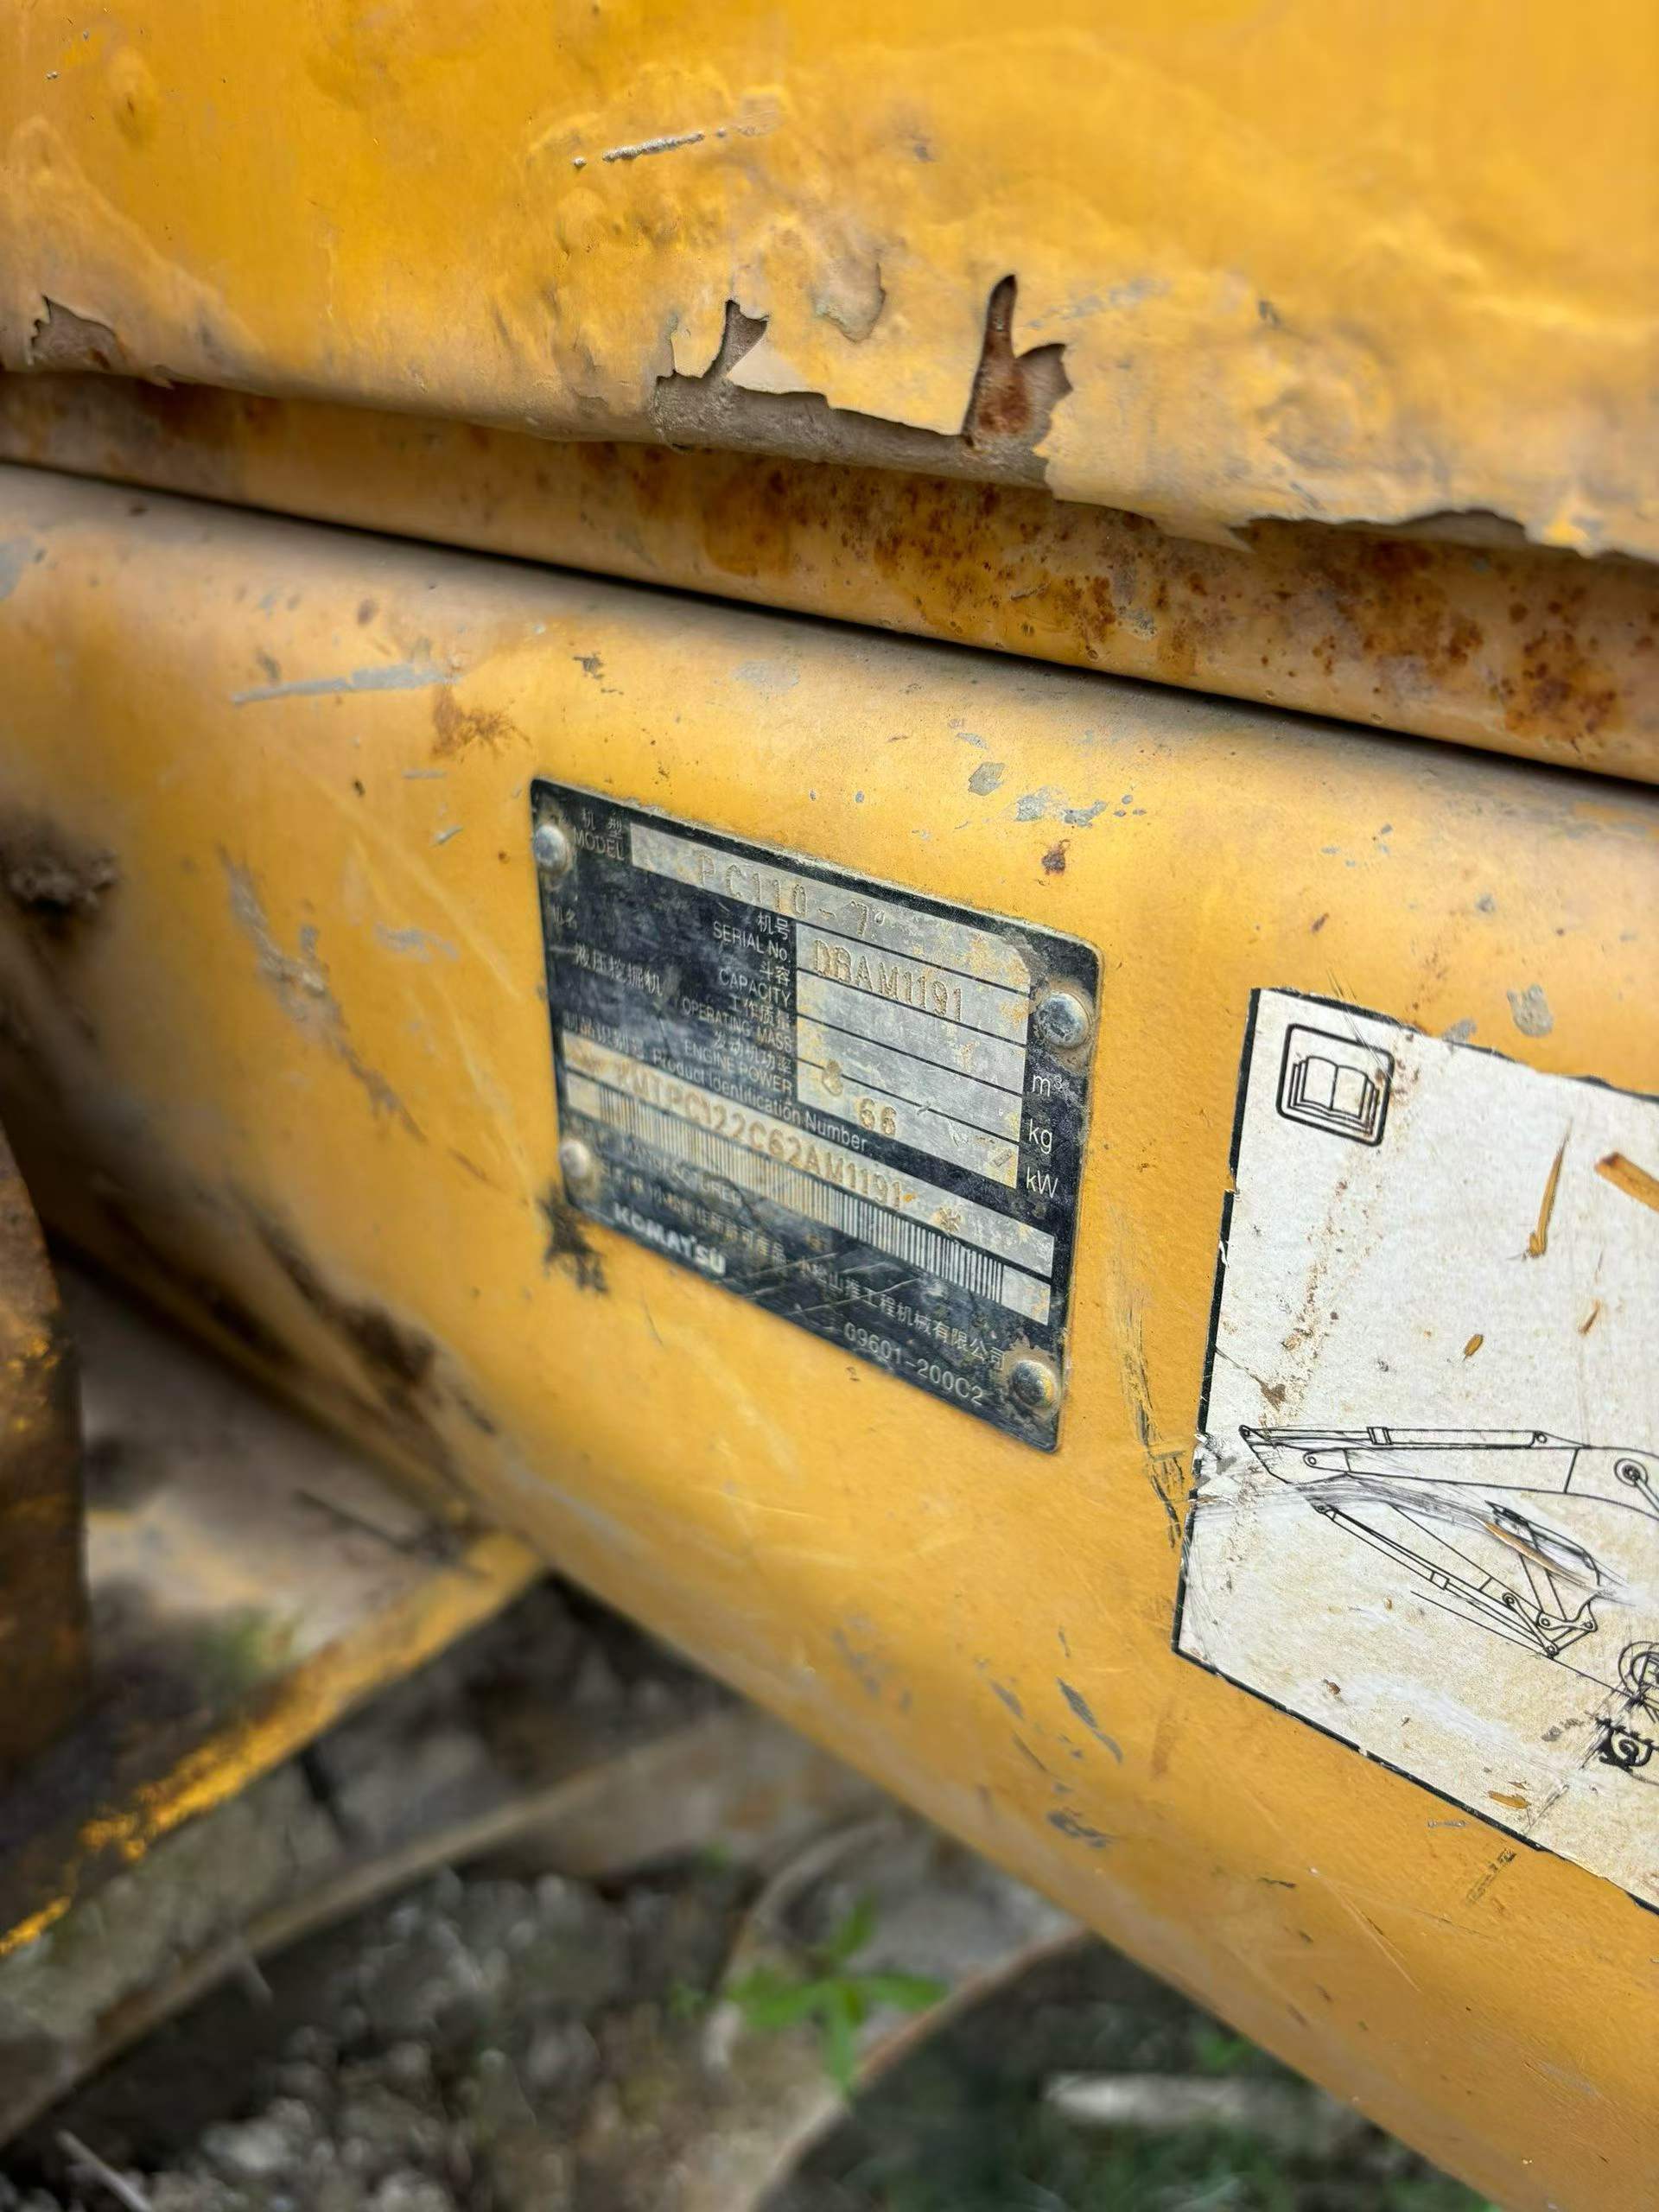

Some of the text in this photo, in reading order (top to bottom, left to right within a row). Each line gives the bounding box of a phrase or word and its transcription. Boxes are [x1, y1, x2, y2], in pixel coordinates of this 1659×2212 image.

[573, 827, 625, 861] MODEL
[712, 919, 766, 957] SERIAL
[756, 911, 790, 942] 机号
[718, 966, 790, 1010] CAPACITY
[682, 995, 791, 1054] OPERATING MASS
[684, 1039, 791, 1097] ENGINE POWER
[653, 1048, 705, 1085] Product
[709, 1070, 803, 1126] Identification
[806, 1111, 867, 1153] Number
[1028, 1118, 1053, 1154] kg
[1026, 1166, 1058, 1199] kW
[613, 1197, 725, 1277] KOMATSU
